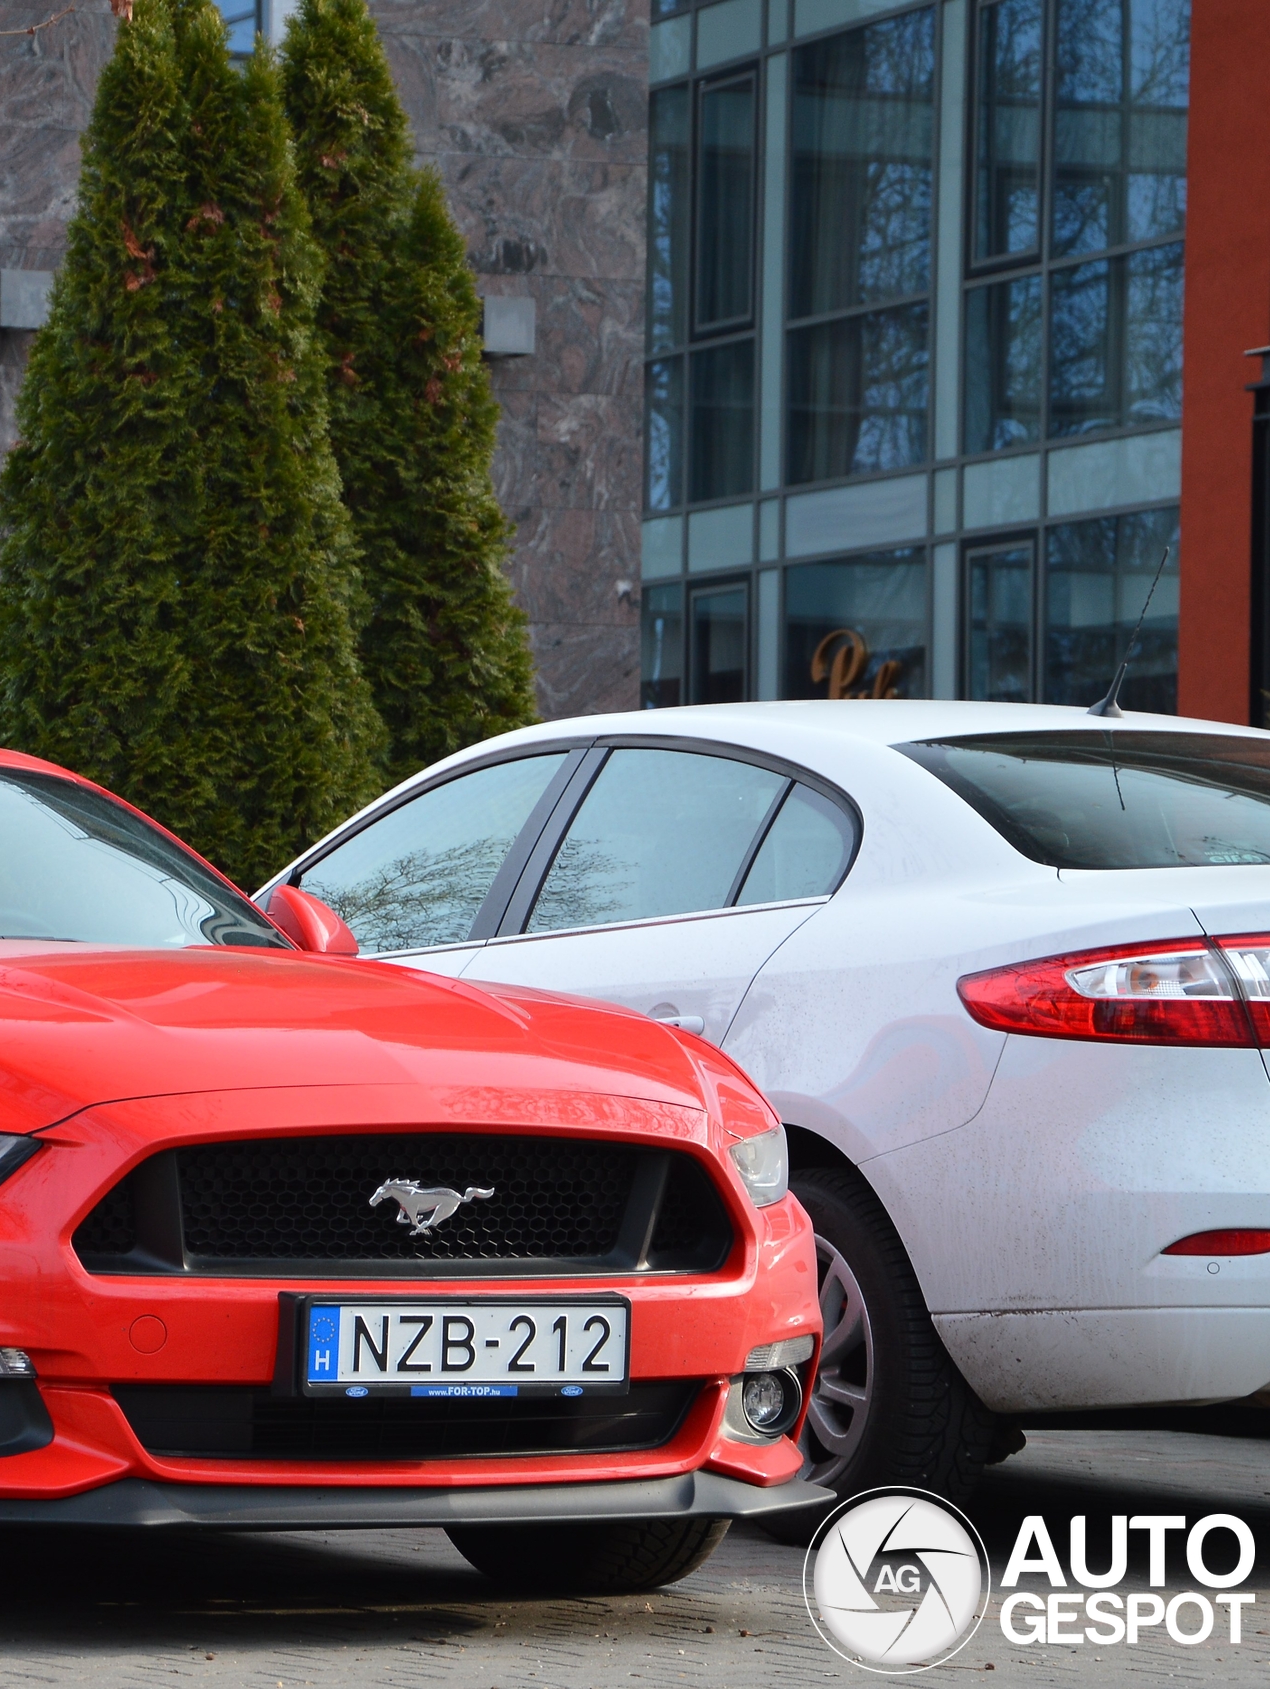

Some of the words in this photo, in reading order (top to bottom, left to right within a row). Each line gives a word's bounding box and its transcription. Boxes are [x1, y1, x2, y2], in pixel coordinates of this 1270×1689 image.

[352, 1314, 612, 1373] NZB-212
[314, 1349, 330, 1371] H
[428, 1386, 501, 1396] www.FOR-TOP.hu
